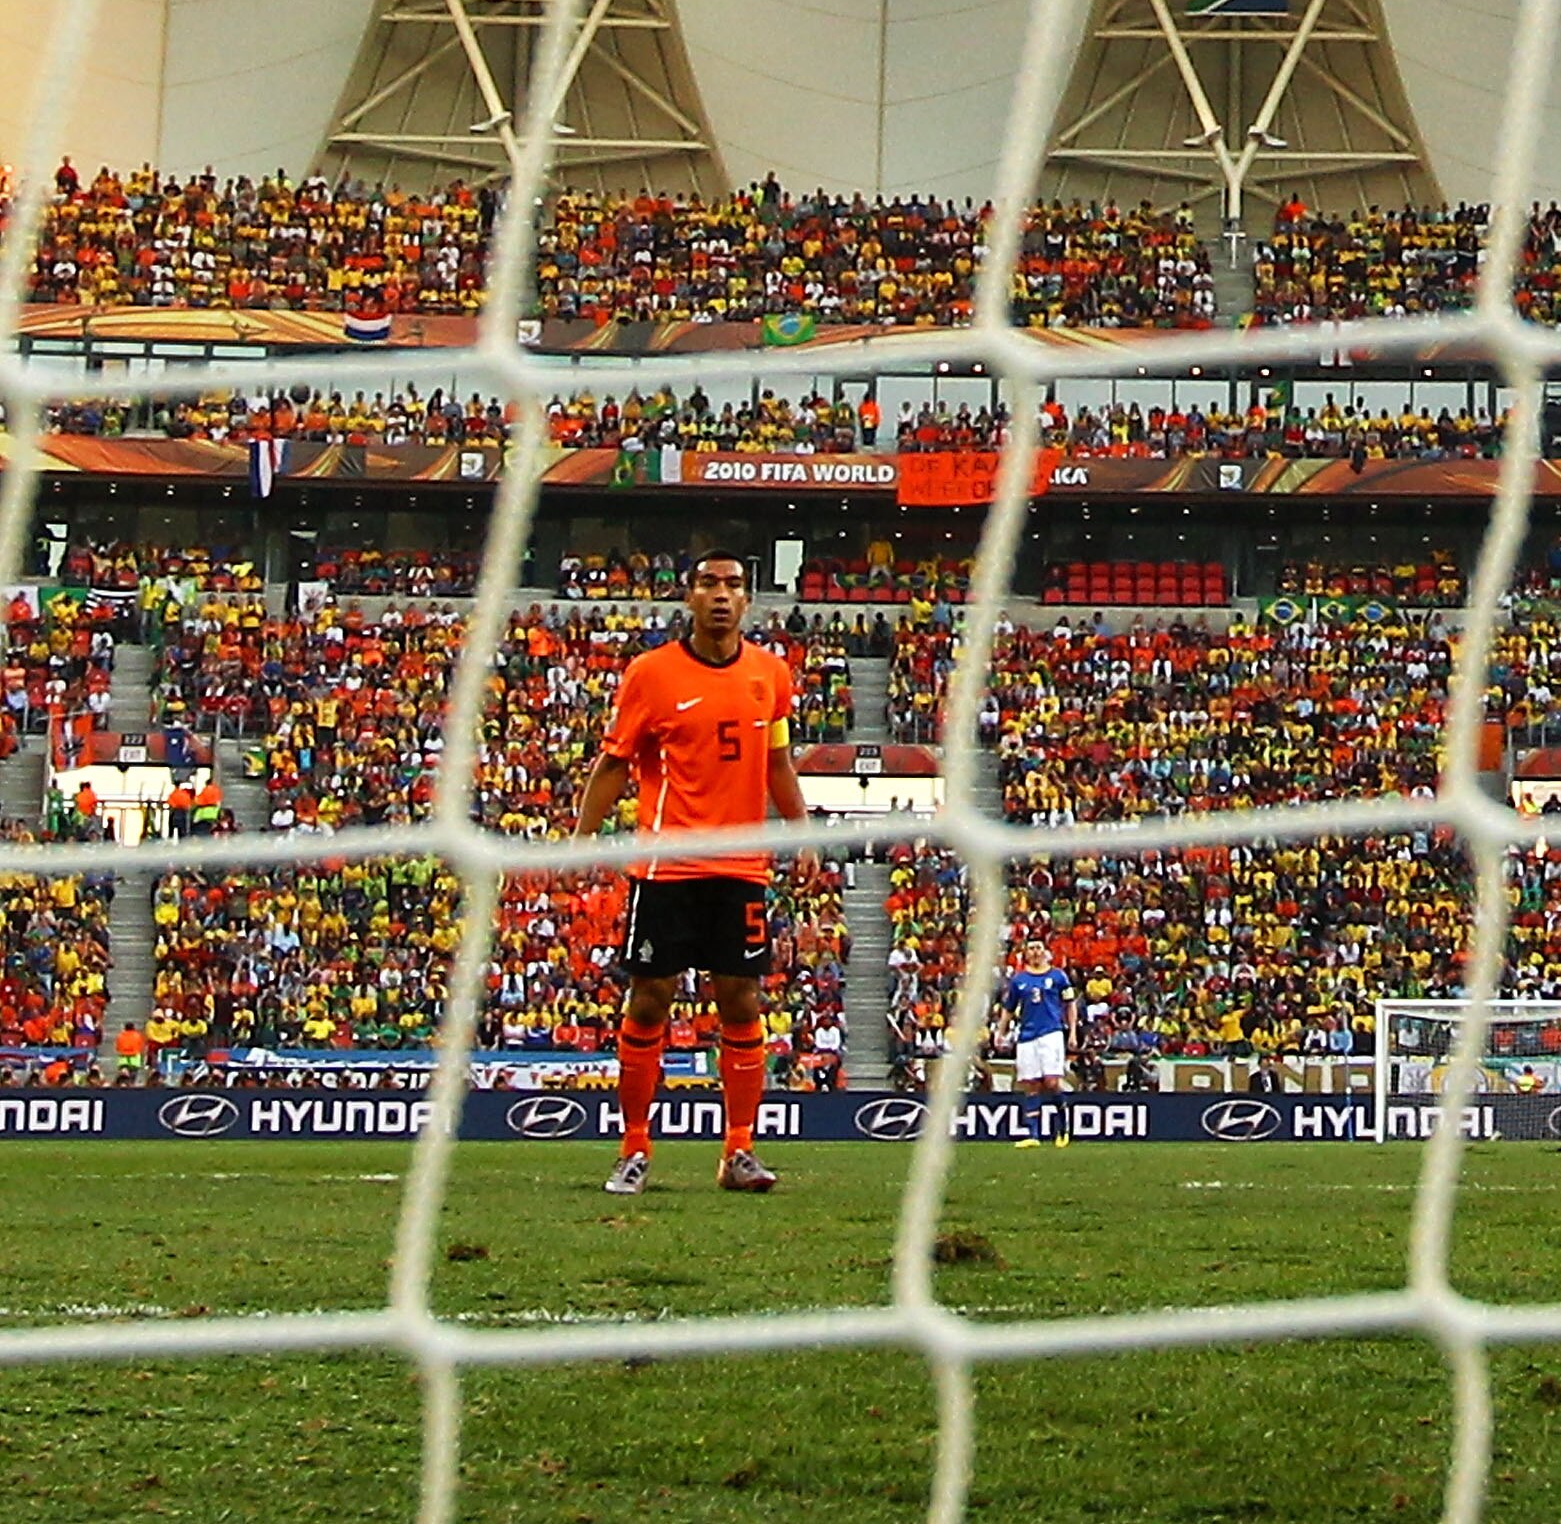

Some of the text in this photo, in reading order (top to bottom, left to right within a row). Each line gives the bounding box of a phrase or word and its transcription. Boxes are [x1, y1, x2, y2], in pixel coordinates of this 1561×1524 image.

[703, 461, 756, 480] 2010
[761, 463, 807, 482] FIFA
[812, 464, 895, 483] WORLD
[717, 720, 741, 761] 5
[744, 902, 765, 944] 5
[250, 1100, 453, 1133] HYUNDA
[598, 1102, 800, 1135] HUNAI
